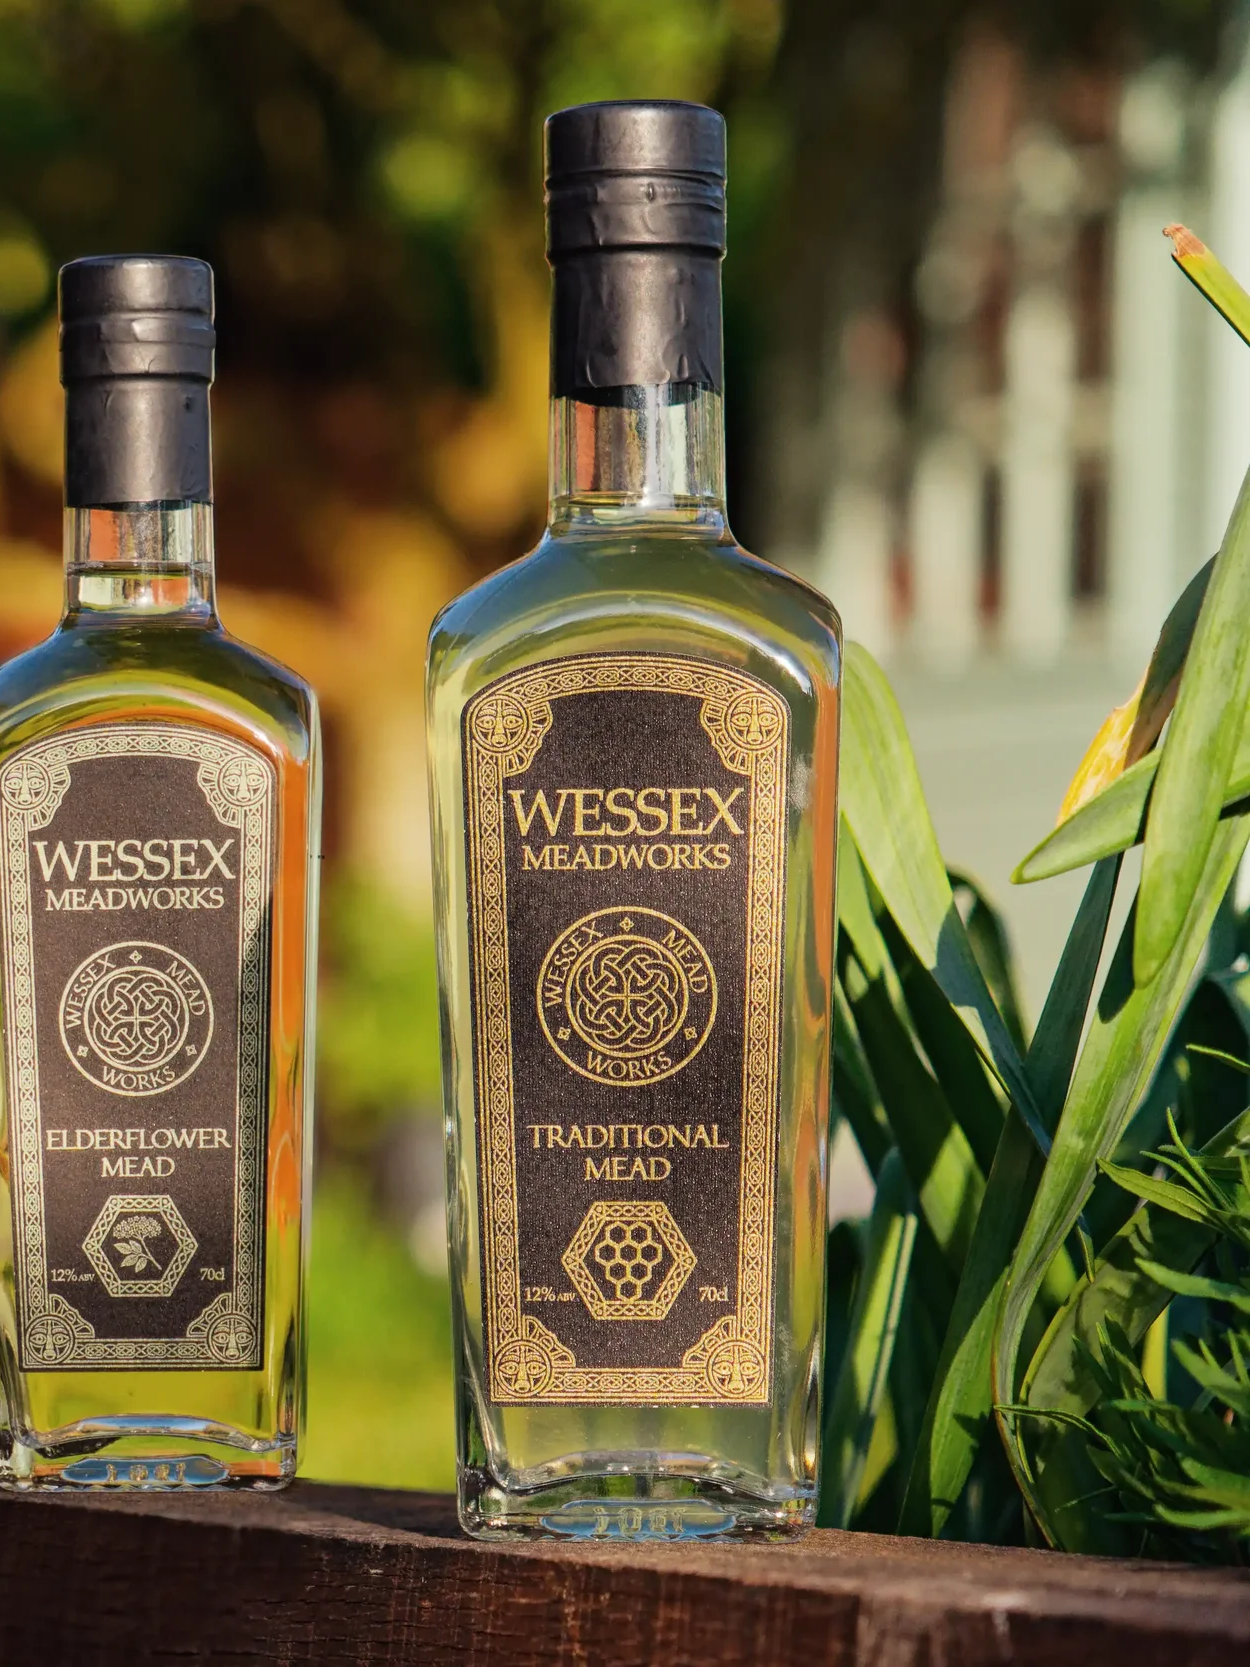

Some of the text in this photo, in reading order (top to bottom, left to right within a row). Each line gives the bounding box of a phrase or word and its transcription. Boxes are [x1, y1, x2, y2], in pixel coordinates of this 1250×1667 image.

[508, 787, 745, 836] WESSEX
[32, 838, 236, 882] WESSEX
[521, 843, 732, 871] MEADWORKS
[45, 887, 225, 911] MEADWORKS
[544, 920, 708, 1008] WESSEX MEAD
[66, 954, 205, 1029] WESSEX MEAD
[586, 1050, 671, 1079] WORKS
[102, 1065, 175, 1090] WORKS
[46, 1128, 232, 1151] ELDERFLOWER
[526, 1123, 730, 1149] TRADITIONAL
[101, 1156, 176, 1178] MEAD
[584, 1157, 672, 1182] MEAD
[199, 1267, 225, 1281] 70cl
[698, 1285, 729, 1303] 70cl
